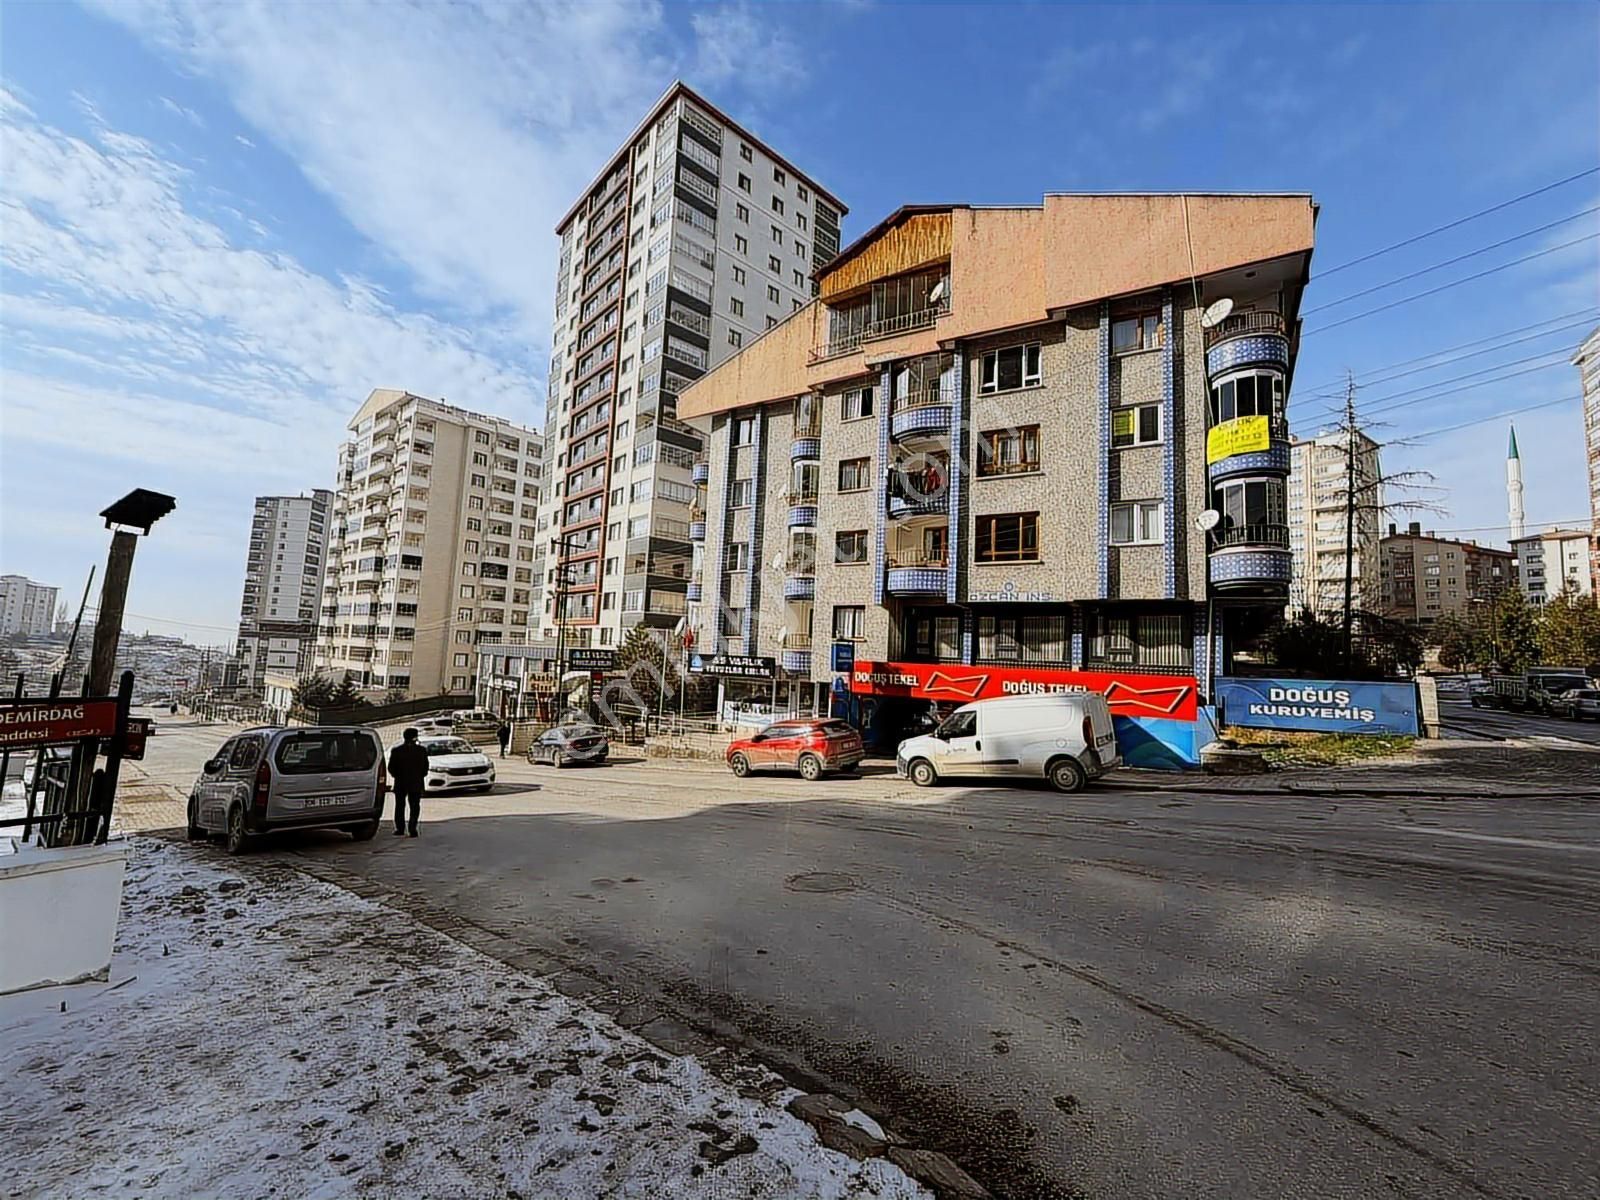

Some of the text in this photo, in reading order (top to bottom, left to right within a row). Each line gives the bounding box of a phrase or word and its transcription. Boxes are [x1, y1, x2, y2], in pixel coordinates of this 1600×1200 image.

[889, 674, 919, 686] TEKEL
[1270, 686, 1350, 708] DOĞUŞ
[1250, 704, 1376, 722] KURUYEMİŞ
[0, 727, 49, 741] addesi
